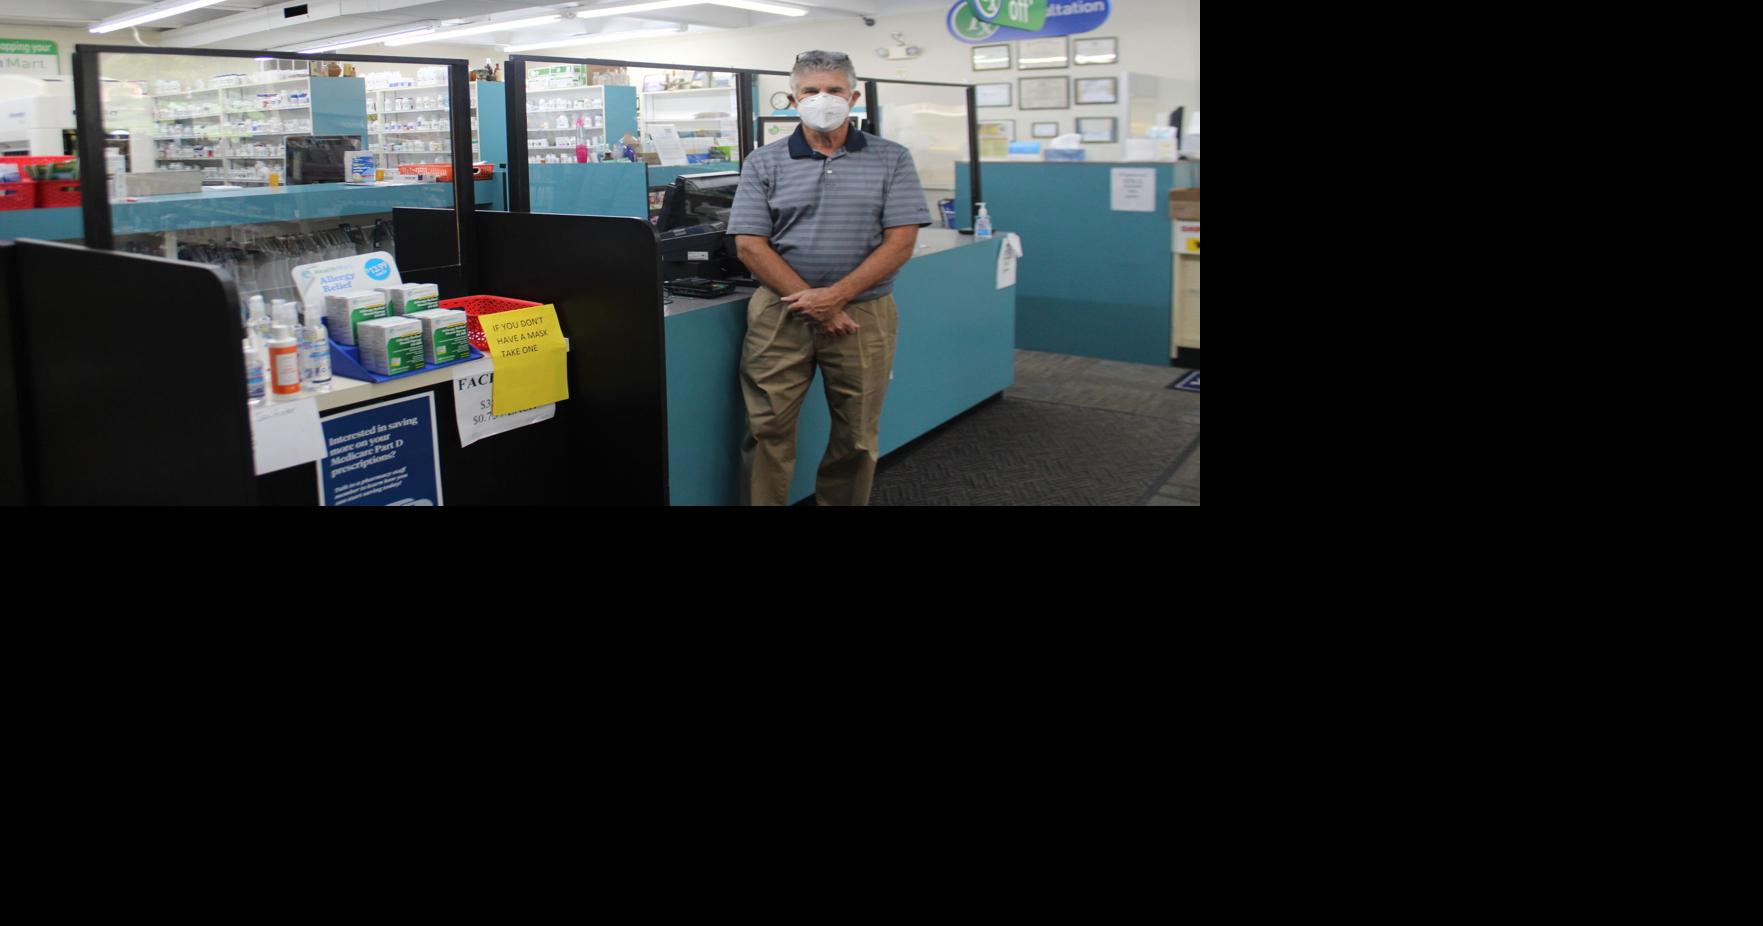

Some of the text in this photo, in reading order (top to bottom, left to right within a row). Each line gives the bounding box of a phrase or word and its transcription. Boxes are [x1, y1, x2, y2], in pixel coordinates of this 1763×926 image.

[493, 317, 543, 332] IF YOU DON'T
[497, 334, 519, 345] HAVE
[527, 329, 549, 339] MASK
[501, 344, 539, 358] TAKE ONE
[329, 417, 418, 446] Interested in saving
[330, 433, 391, 456] more on your
[330, 439, 404, 466] Medicare Part D
[331, 450, 397, 478] prescriptions?
